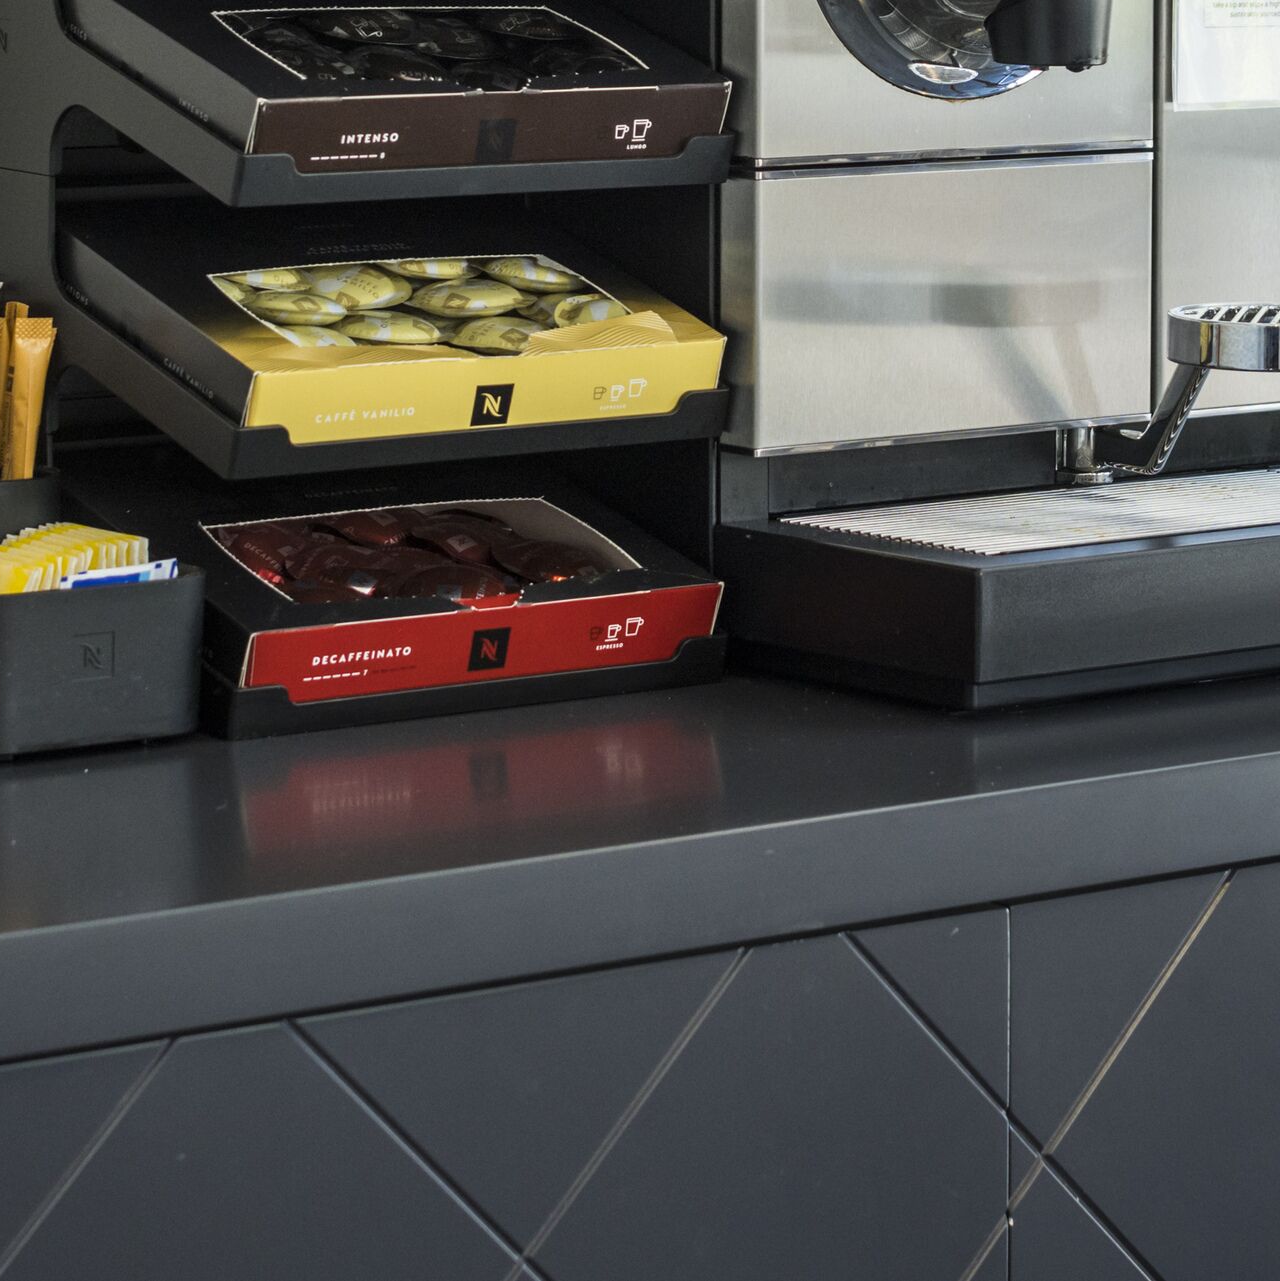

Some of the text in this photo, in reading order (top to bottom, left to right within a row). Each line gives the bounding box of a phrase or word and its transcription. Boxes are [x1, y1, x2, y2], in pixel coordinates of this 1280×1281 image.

[340, 132, 399, 144] INTENSO
[315, 406, 415, 424] CAFFÈ VANILIO
[595, 641, 624, 651] ESPRESSO
[312, 645, 412, 667] DECAFFEINATO
